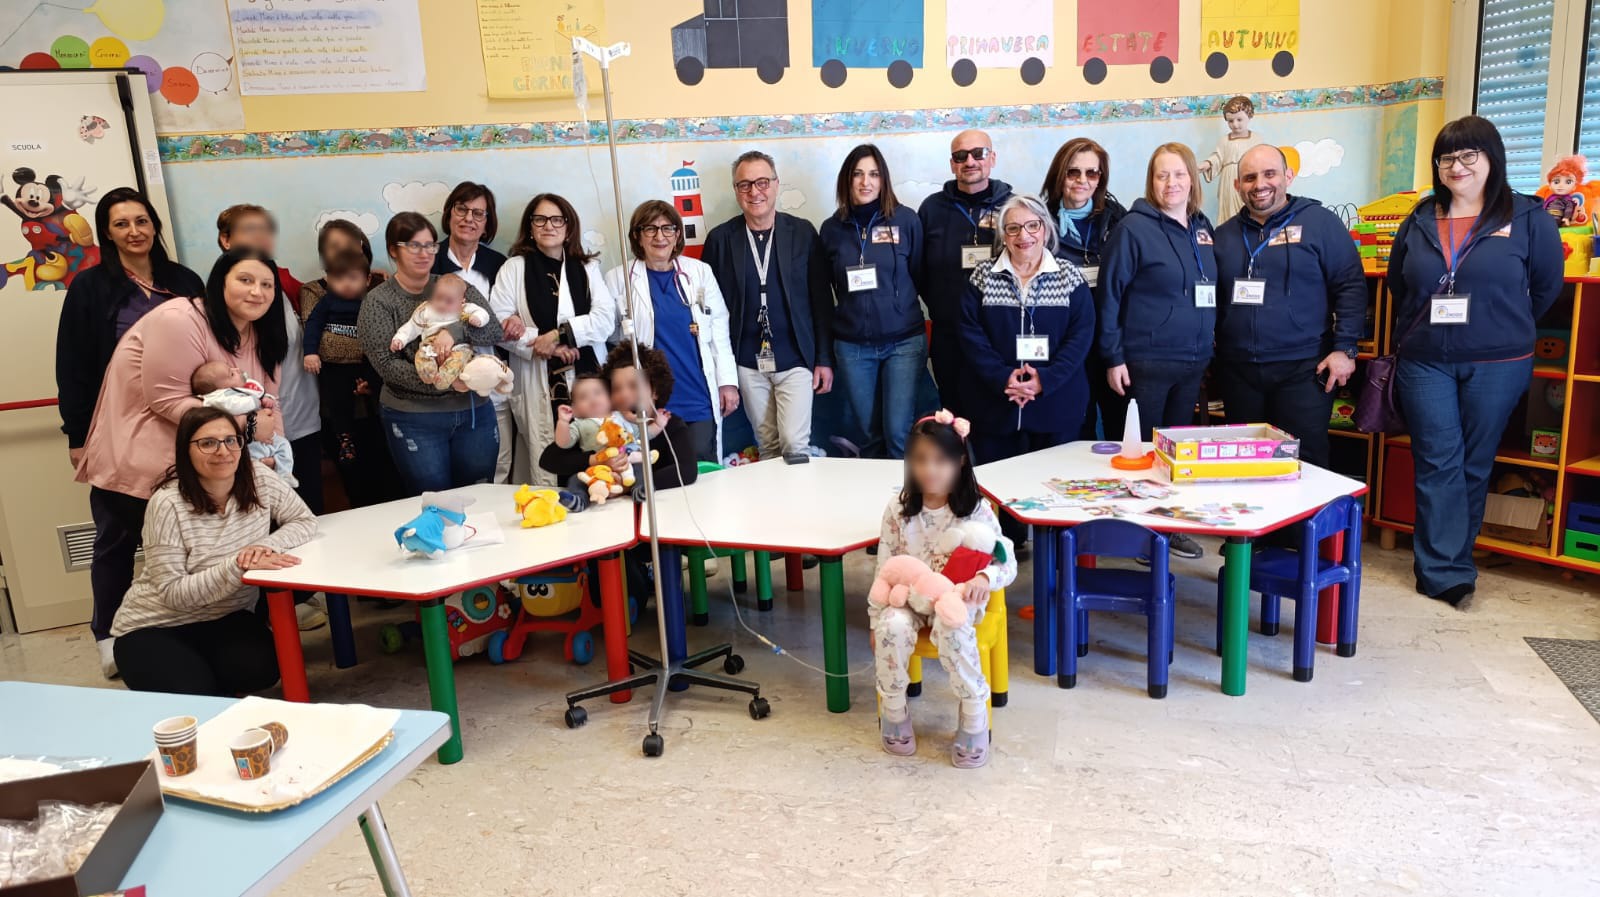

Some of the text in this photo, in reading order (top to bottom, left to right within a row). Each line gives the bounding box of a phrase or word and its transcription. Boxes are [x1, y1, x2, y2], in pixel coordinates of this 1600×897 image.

[825, 35, 921, 57] INVERNO
[947, 34, 1049, 57] PRIMAVERA
[1083, 31, 1168, 53] ESTATE
[1208, 29, 1298, 49] AUTUNNO
[11, 143, 42, 151] SCUOLA
